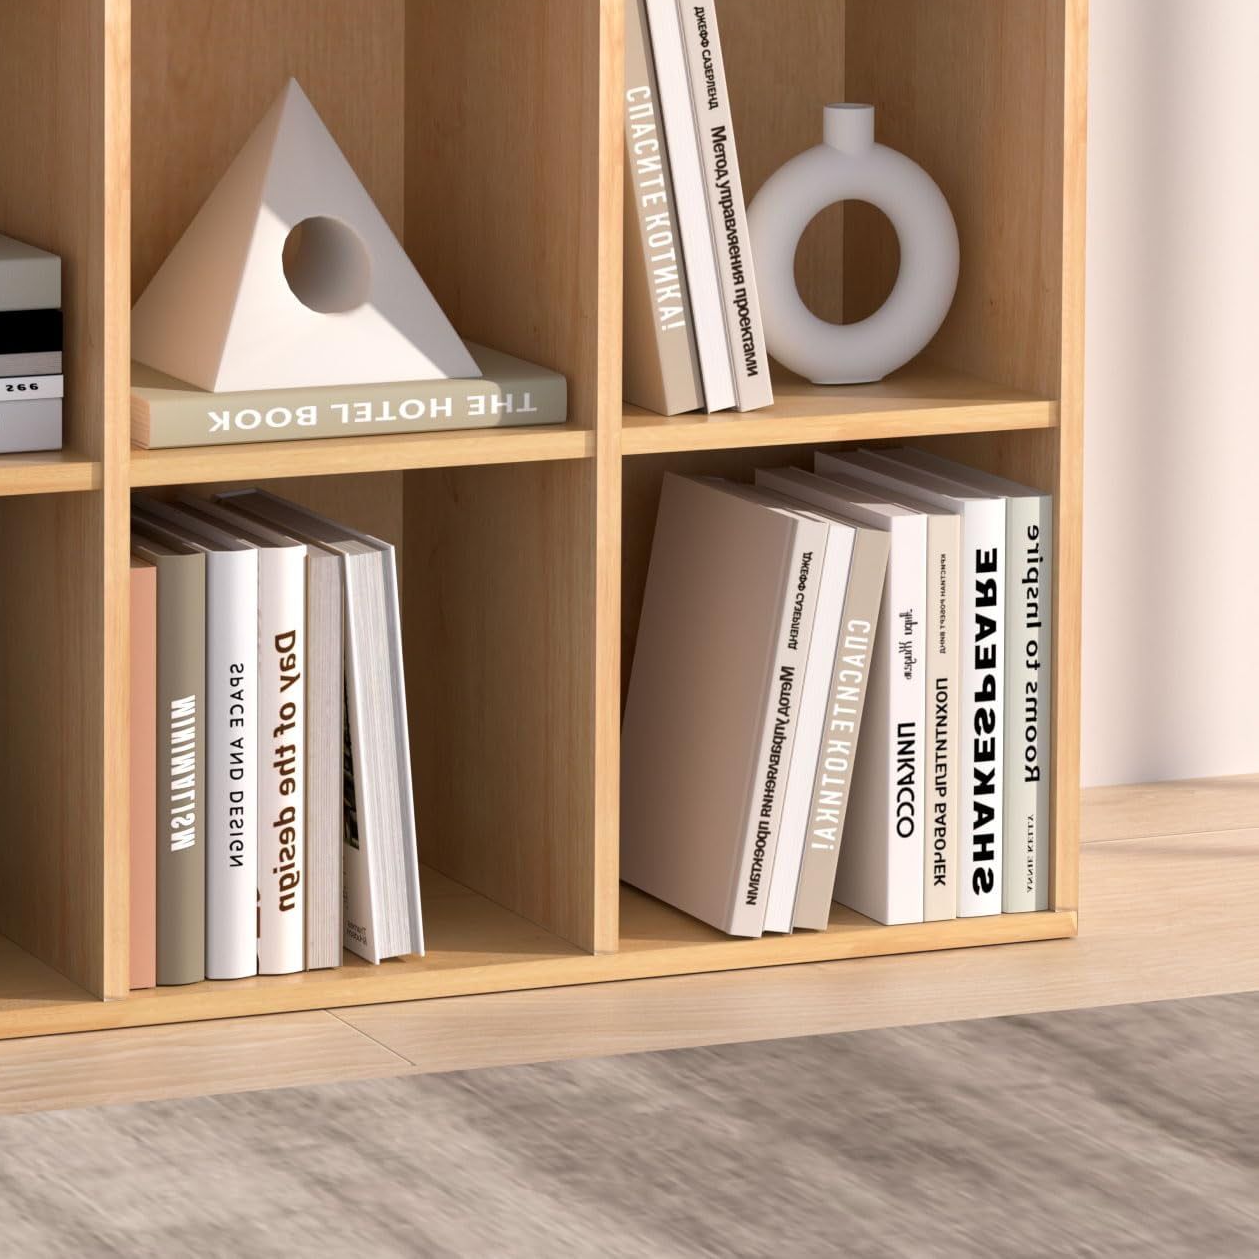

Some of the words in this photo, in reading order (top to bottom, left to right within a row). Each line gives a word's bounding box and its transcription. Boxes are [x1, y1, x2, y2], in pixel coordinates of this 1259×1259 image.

[693, 5, 709, 48] ДЖЕФФ
[702, 49, 719, 110] САЗЕРЛЕНД
[626, 85, 667, 208] СПАСИТЕ
[711, 125, 729, 181] Метод
[645, 212, 685, 332] КОТИКА!
[716, 180, 746, 286] управляения
[735, 287, 758, 377] проектами
[208, 405, 318, 432] BOOK
[330, 397, 452, 424] HOTEL
[467, 391, 537, 415] THE
